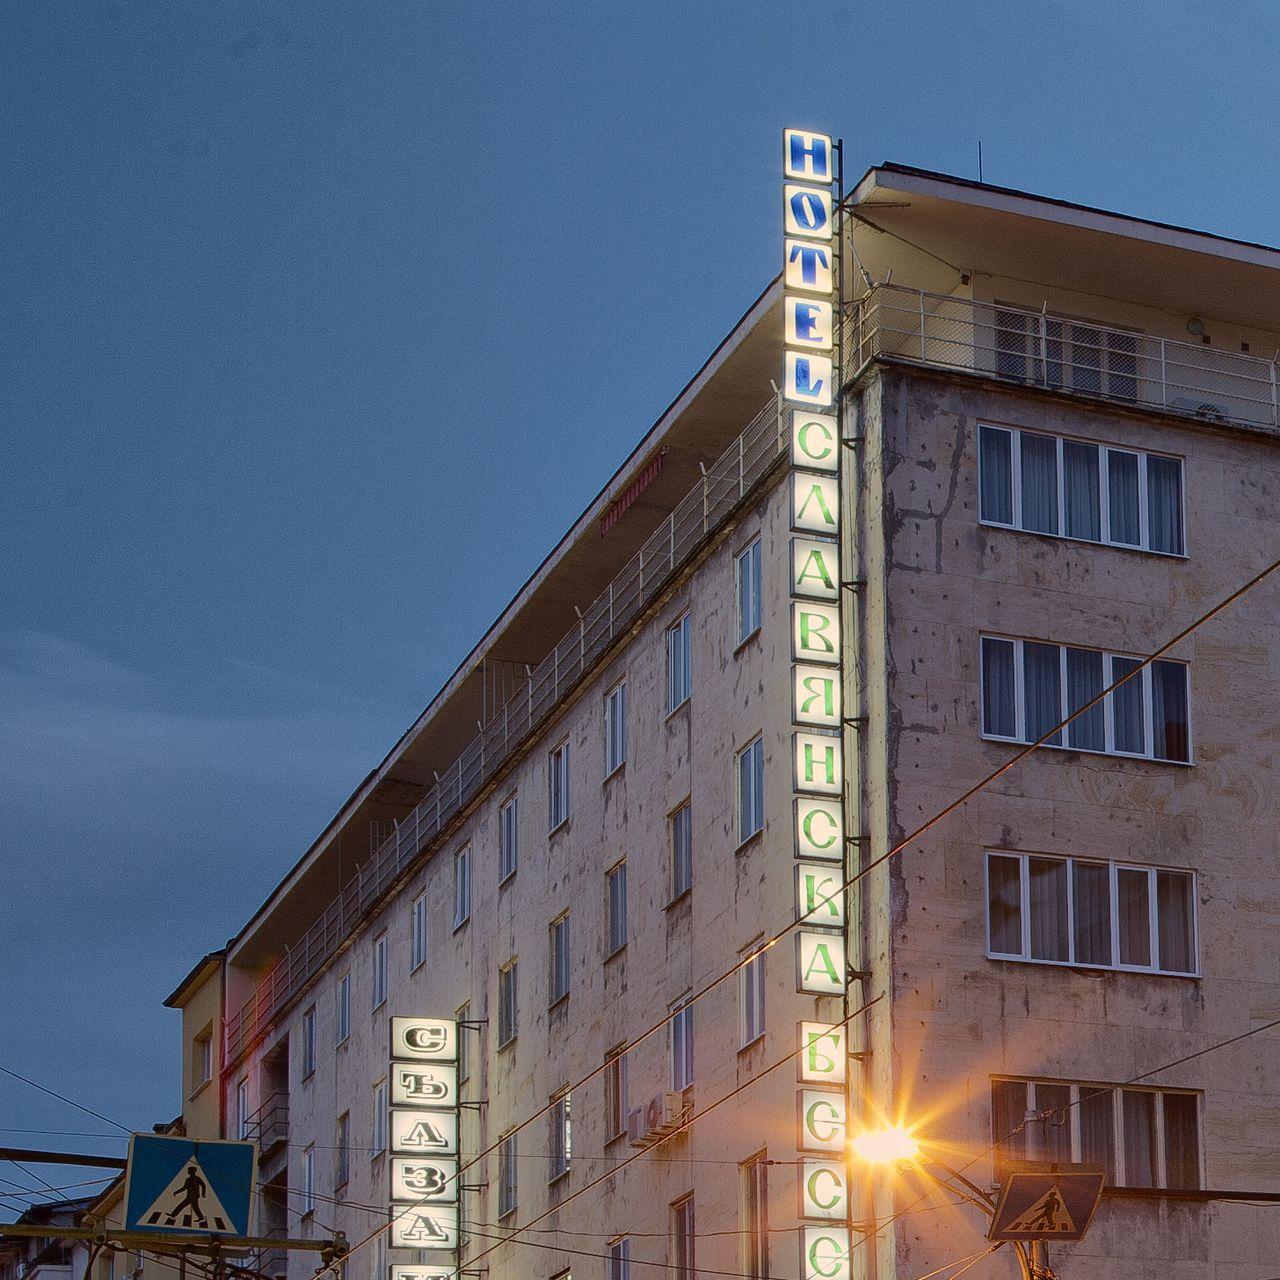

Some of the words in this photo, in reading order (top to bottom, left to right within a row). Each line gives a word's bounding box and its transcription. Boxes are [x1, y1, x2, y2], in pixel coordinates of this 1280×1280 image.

[789, 134, 830, 396] HOTEL
[797, 420, 842, 985] СЛАВЯНСКА
[401, 1024, 449, 1242] СЪЛЗА
